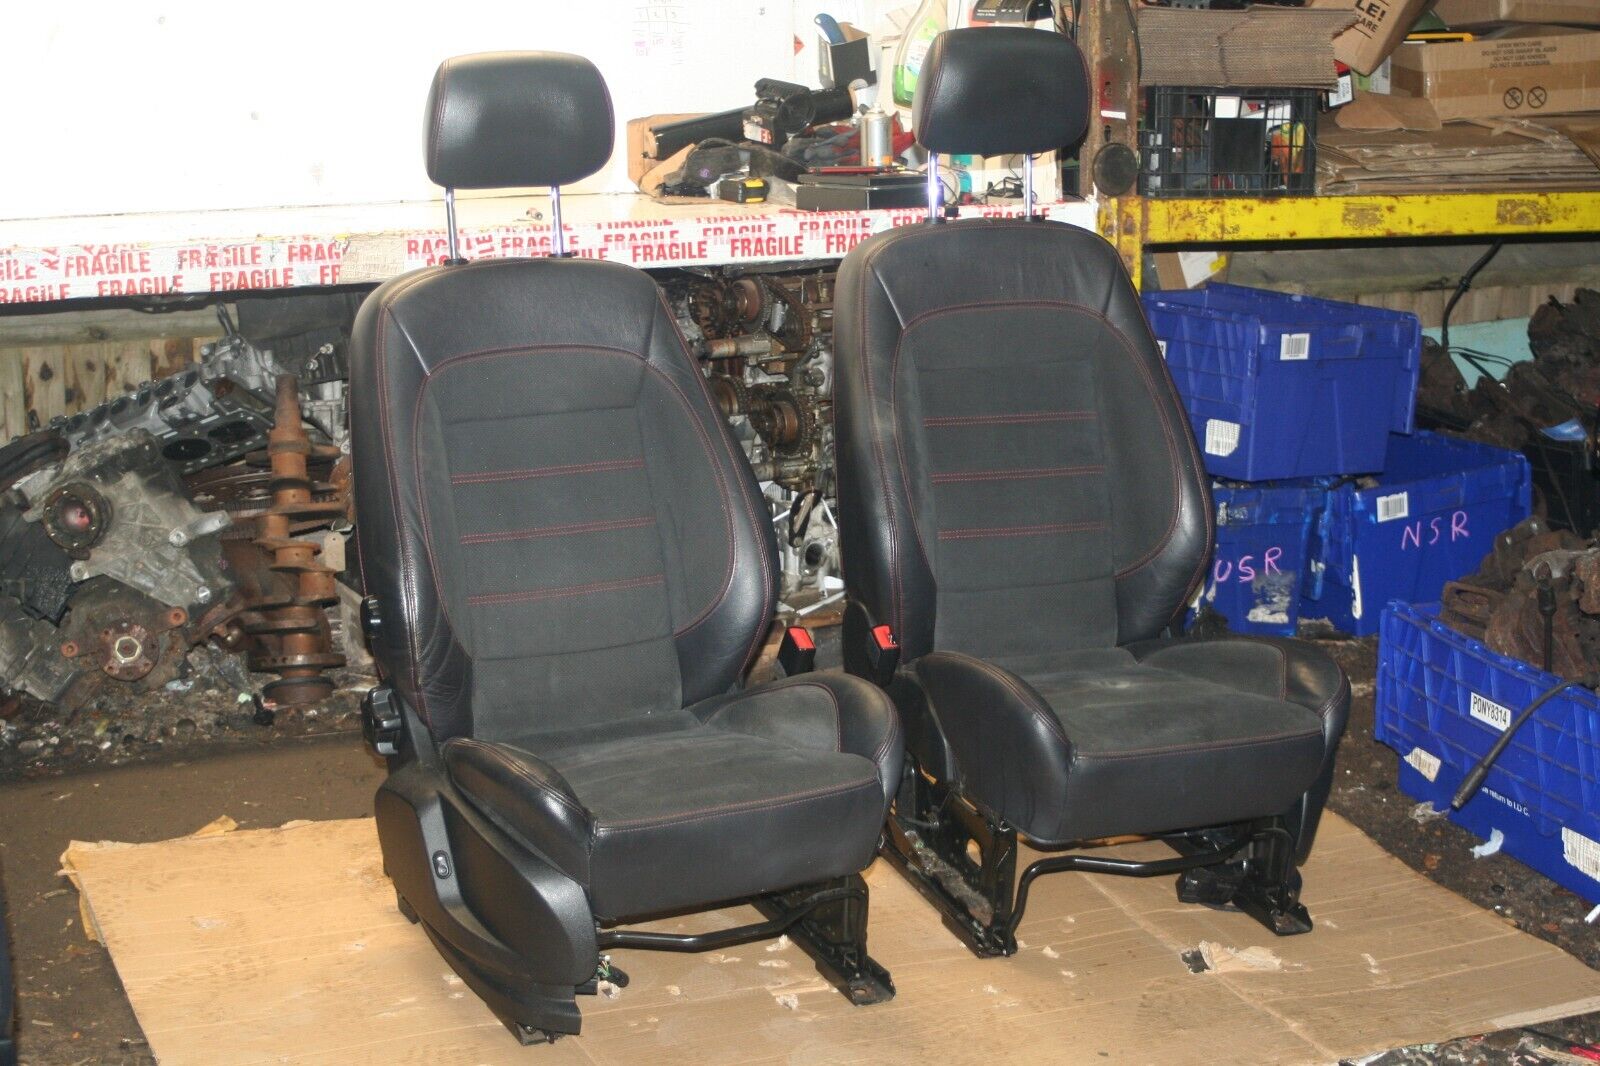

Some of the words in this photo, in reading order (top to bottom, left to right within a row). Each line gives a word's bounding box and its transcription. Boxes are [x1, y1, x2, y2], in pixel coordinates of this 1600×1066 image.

[1358, 15, 1379, 33] ARE
[631, 240, 708, 263] FRAGILE
[730, 235, 804, 258] FRAGILE
[64, 250, 152, 278] FRAGILE
[97, 274, 184, 297] FRAGILE
[209, 266, 295, 293] FRAGILE
[1401, 511, 1470, 550] NSR
